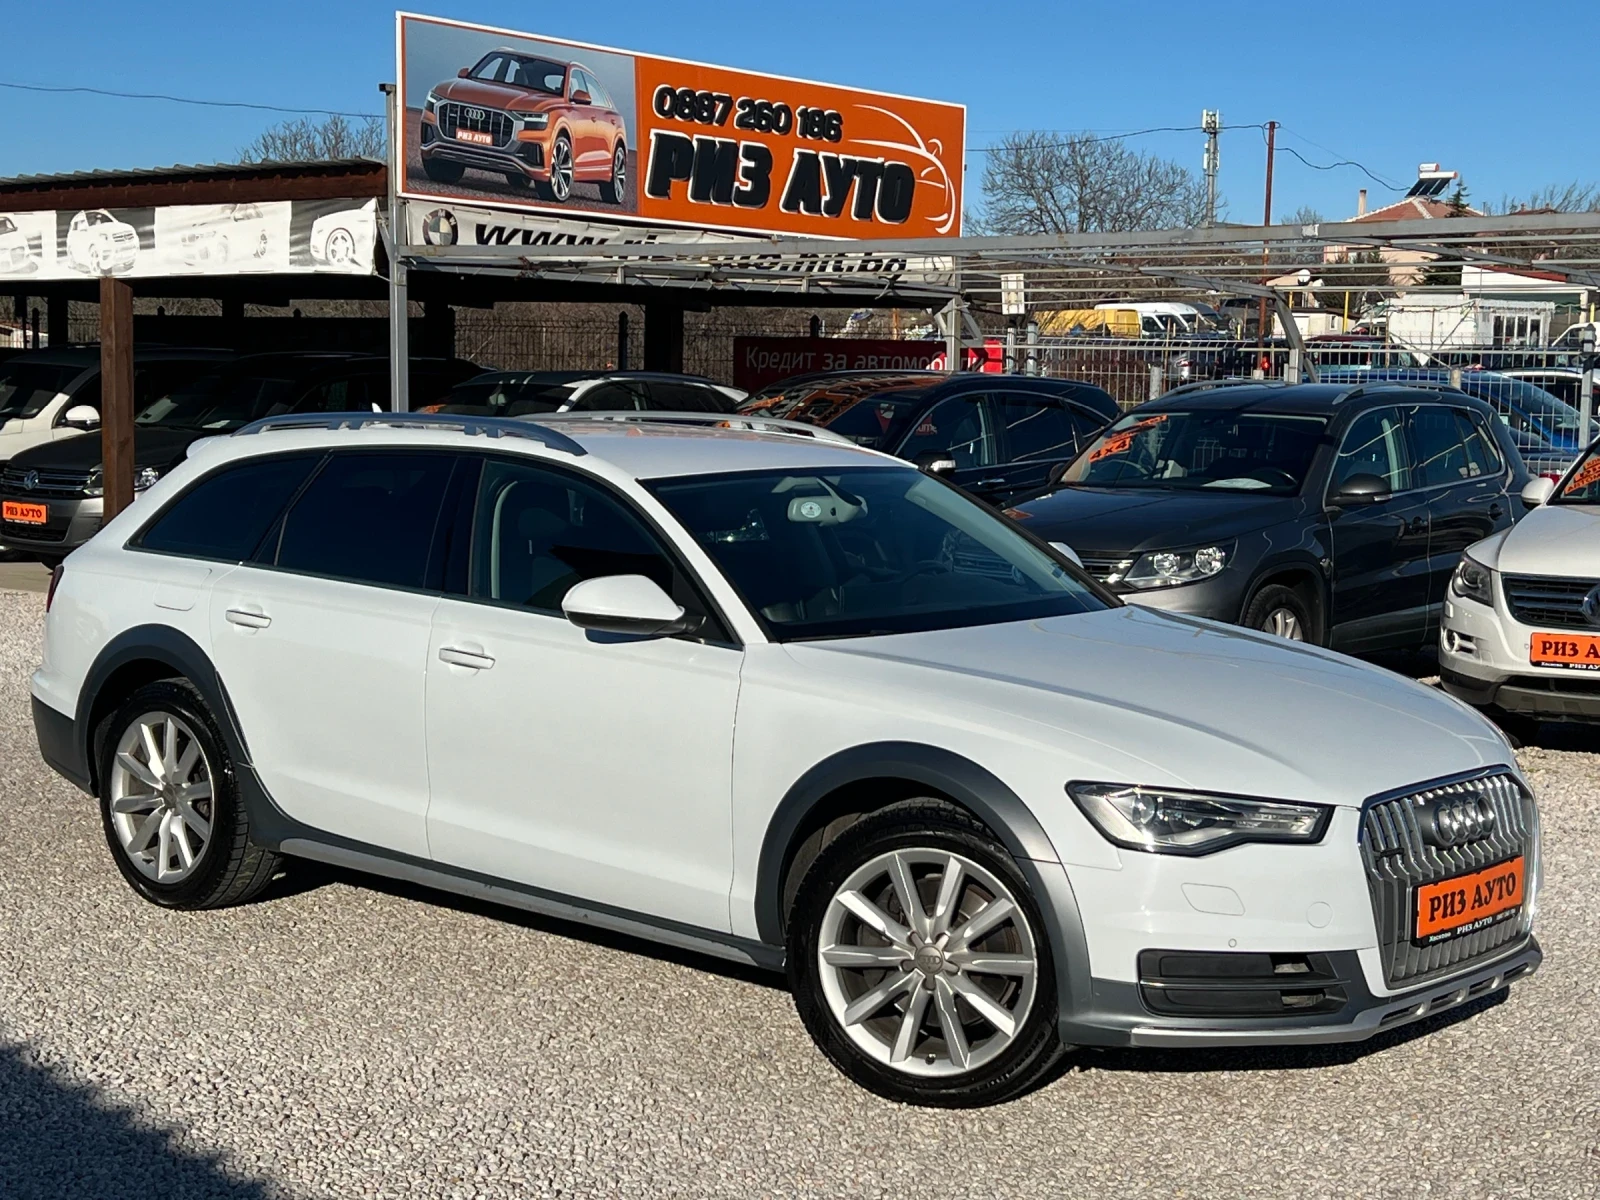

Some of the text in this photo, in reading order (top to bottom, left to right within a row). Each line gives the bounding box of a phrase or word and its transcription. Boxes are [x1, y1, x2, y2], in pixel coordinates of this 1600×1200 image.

[653, 84, 843, 143] 0887 260 186
[644, 128, 916, 225] РИЗ АУТО
[746, 346, 816, 373] Кредит
[821, 352, 848, 371] за
[1541, 640, 1579, 658] РИЗ
[1428, 872, 1516, 922] РИЗ АУТО
